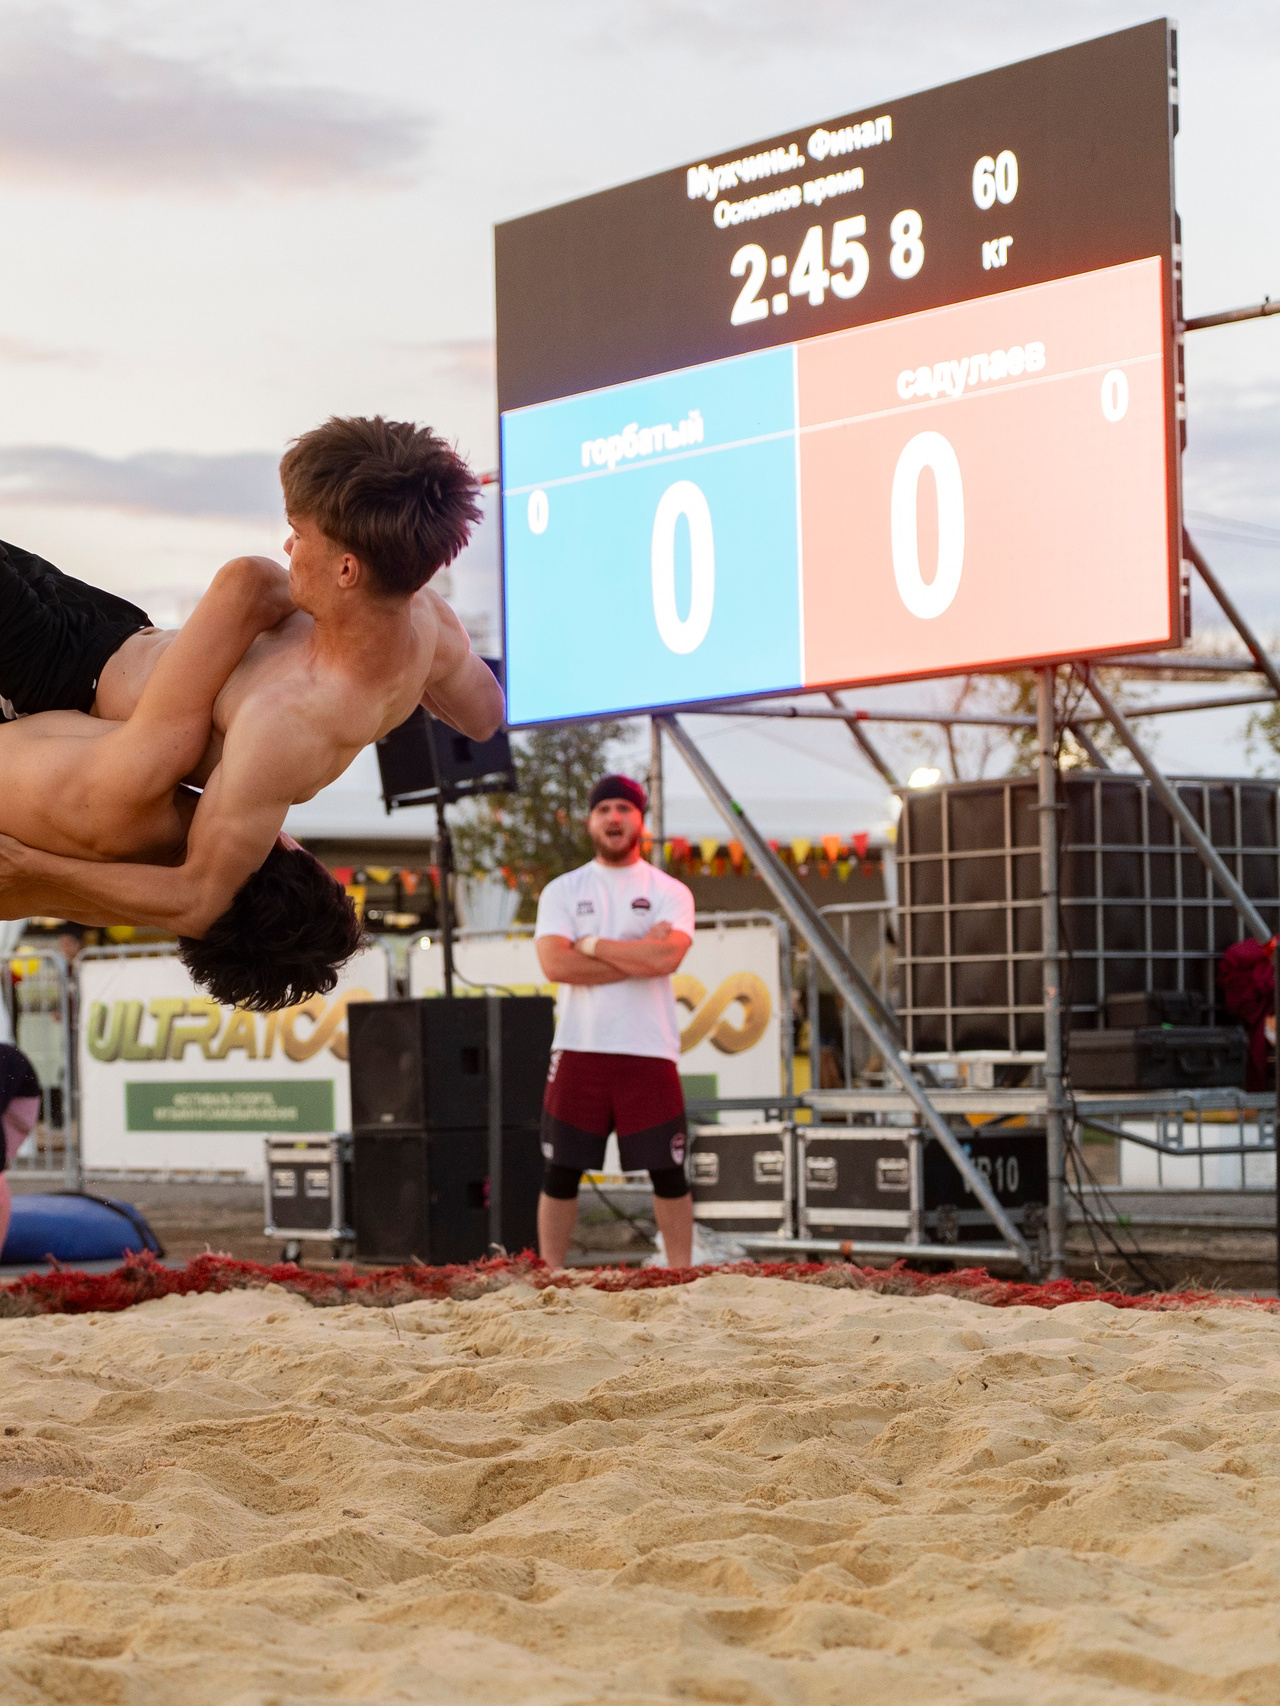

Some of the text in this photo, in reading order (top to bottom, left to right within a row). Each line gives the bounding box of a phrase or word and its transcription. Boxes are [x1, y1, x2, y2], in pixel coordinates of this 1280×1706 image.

[808, 115, 893, 161] Финал
[972, 150, 1019, 210] 60
[730, 209, 925, 326] 2:45 8
[982, 235, 1014, 271] кг
[897, 341, 1047, 399] садулаев
[1101, 368, 1129, 423] 0
[581, 408, 705, 470] горбатый
[527, 489, 550, 535] 0
[891, 430, 965, 619] 0
[651, 479, 716, 655] 0
